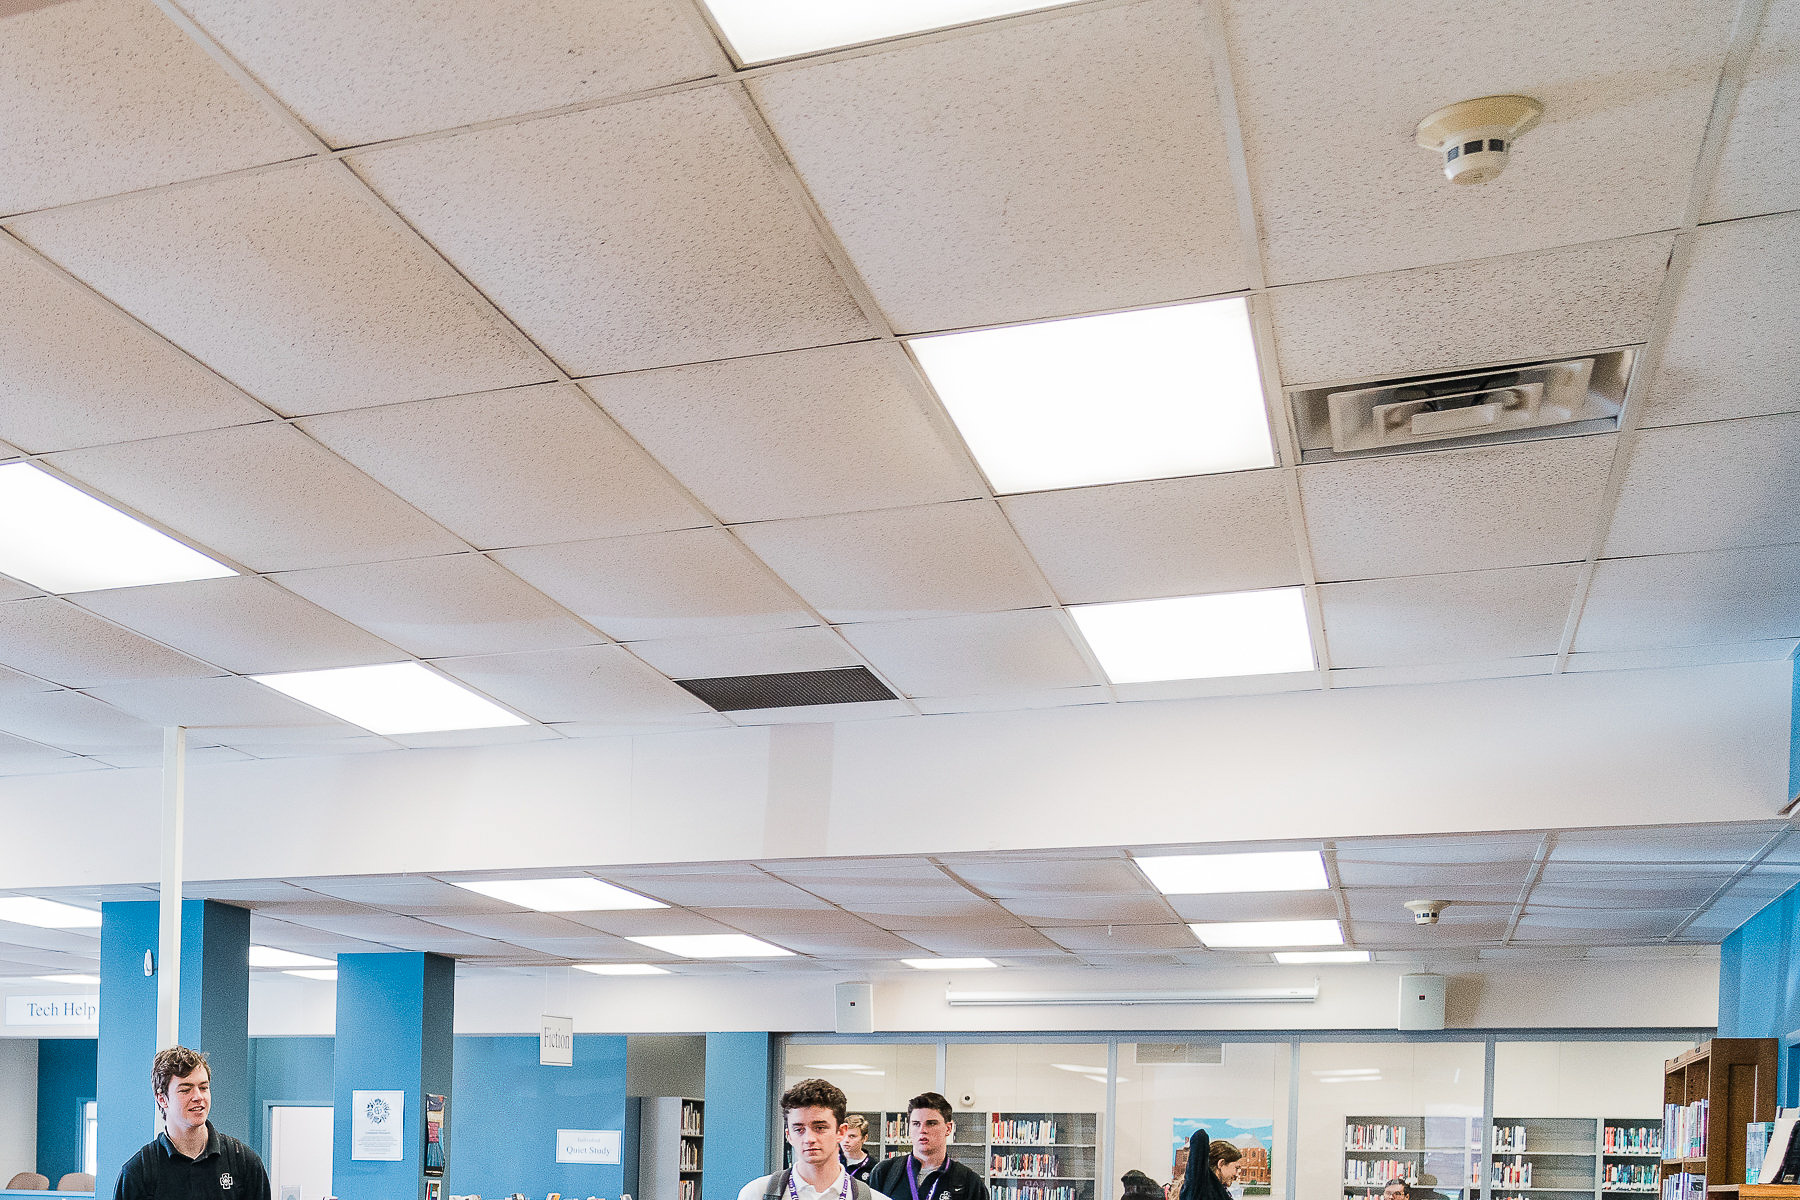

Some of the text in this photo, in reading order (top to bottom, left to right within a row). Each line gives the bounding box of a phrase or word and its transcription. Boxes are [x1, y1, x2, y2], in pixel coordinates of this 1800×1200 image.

[26, 1002, 96, 1020] Tech Help
[544, 1027, 570, 1049] Fiction
[566, 1146, 610, 1157] Quiet Study
